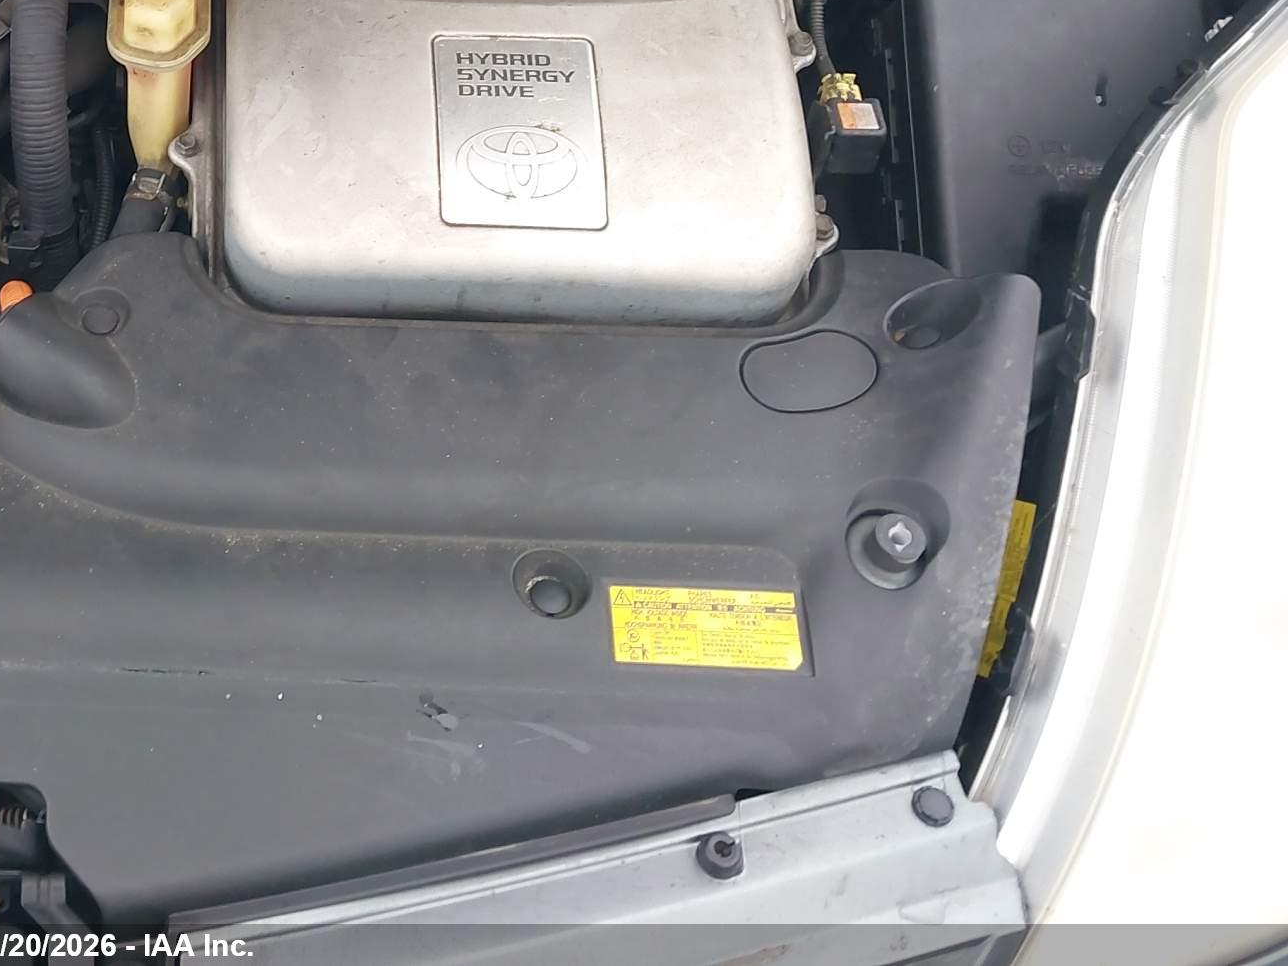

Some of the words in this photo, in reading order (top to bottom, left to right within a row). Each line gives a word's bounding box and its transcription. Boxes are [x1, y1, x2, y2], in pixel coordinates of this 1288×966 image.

[456, 52, 551, 67] HYBRID
[457, 68, 575, 83] SYNERGY
[458, 84, 535, 98] DRIVE
